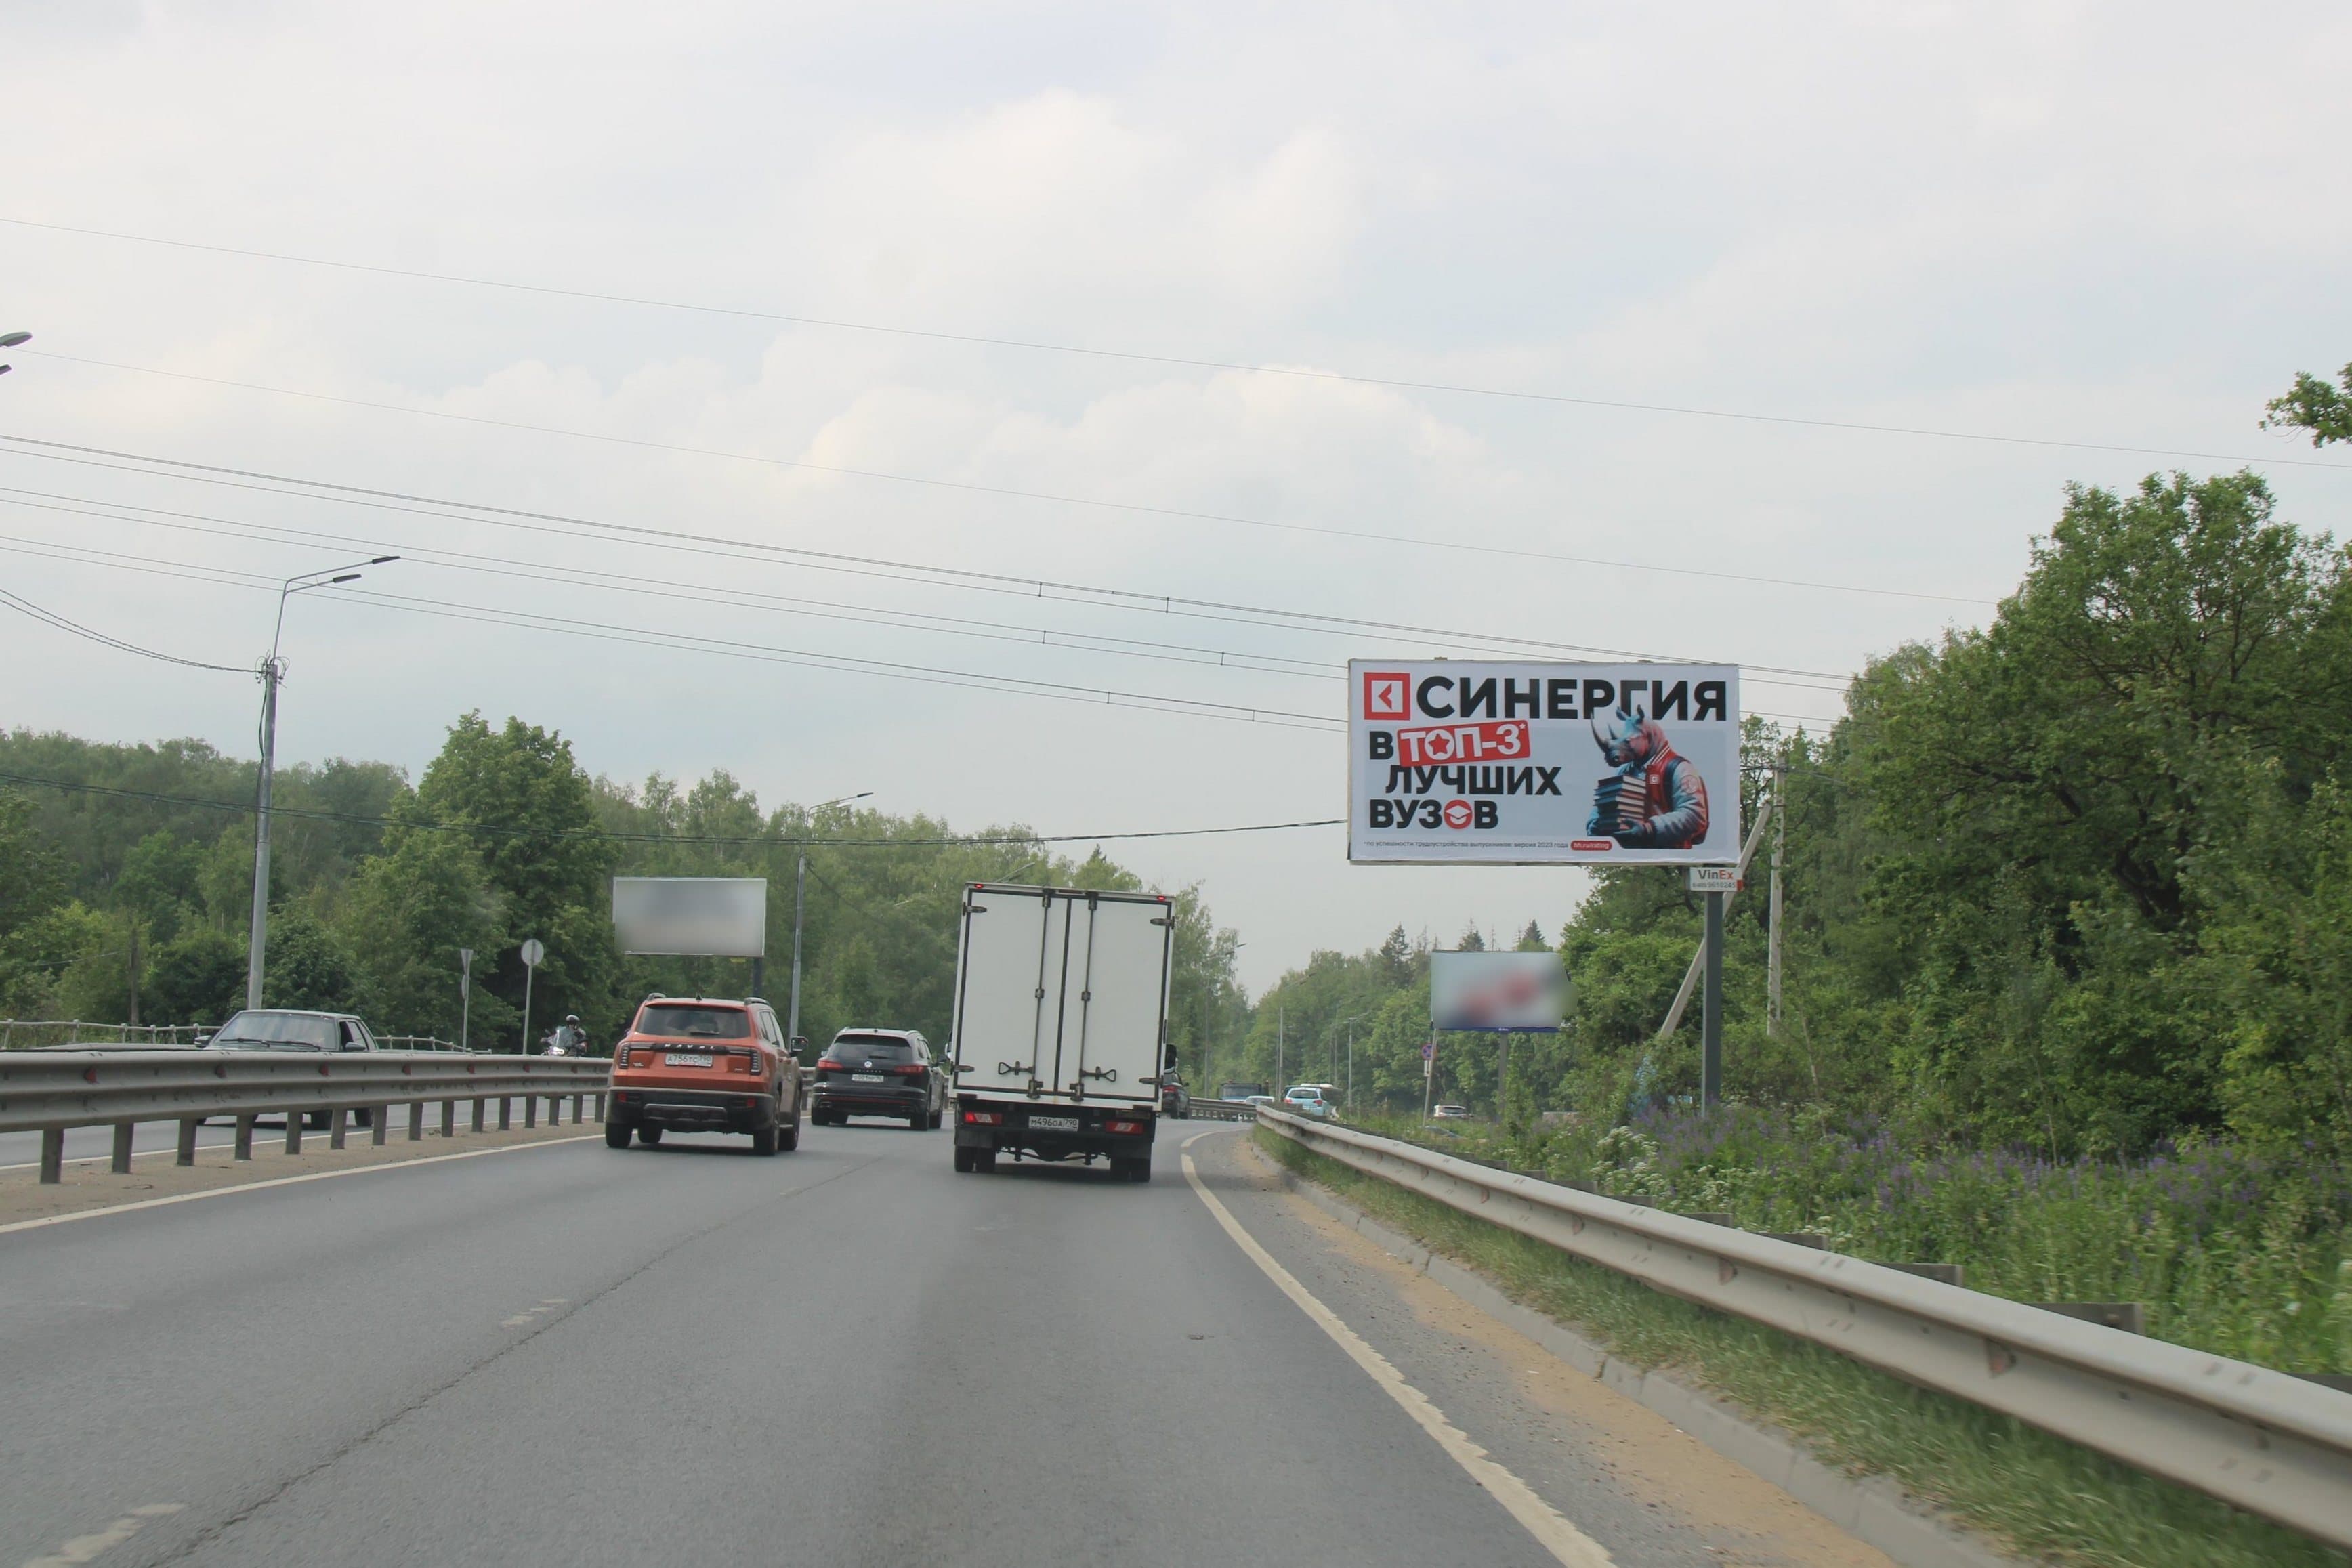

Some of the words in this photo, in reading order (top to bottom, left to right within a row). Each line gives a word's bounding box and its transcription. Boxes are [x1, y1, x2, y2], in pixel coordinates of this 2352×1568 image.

[1416, 676, 1727, 721] СИНЕРГИЯ
[1369, 730, 1394, 760] В
[1385, 765, 1562, 796] ЛУЧШИХ
[1369, 799, 1499, 830] ВУЗОВ
[1698, 870, 1734, 879] VinEx
